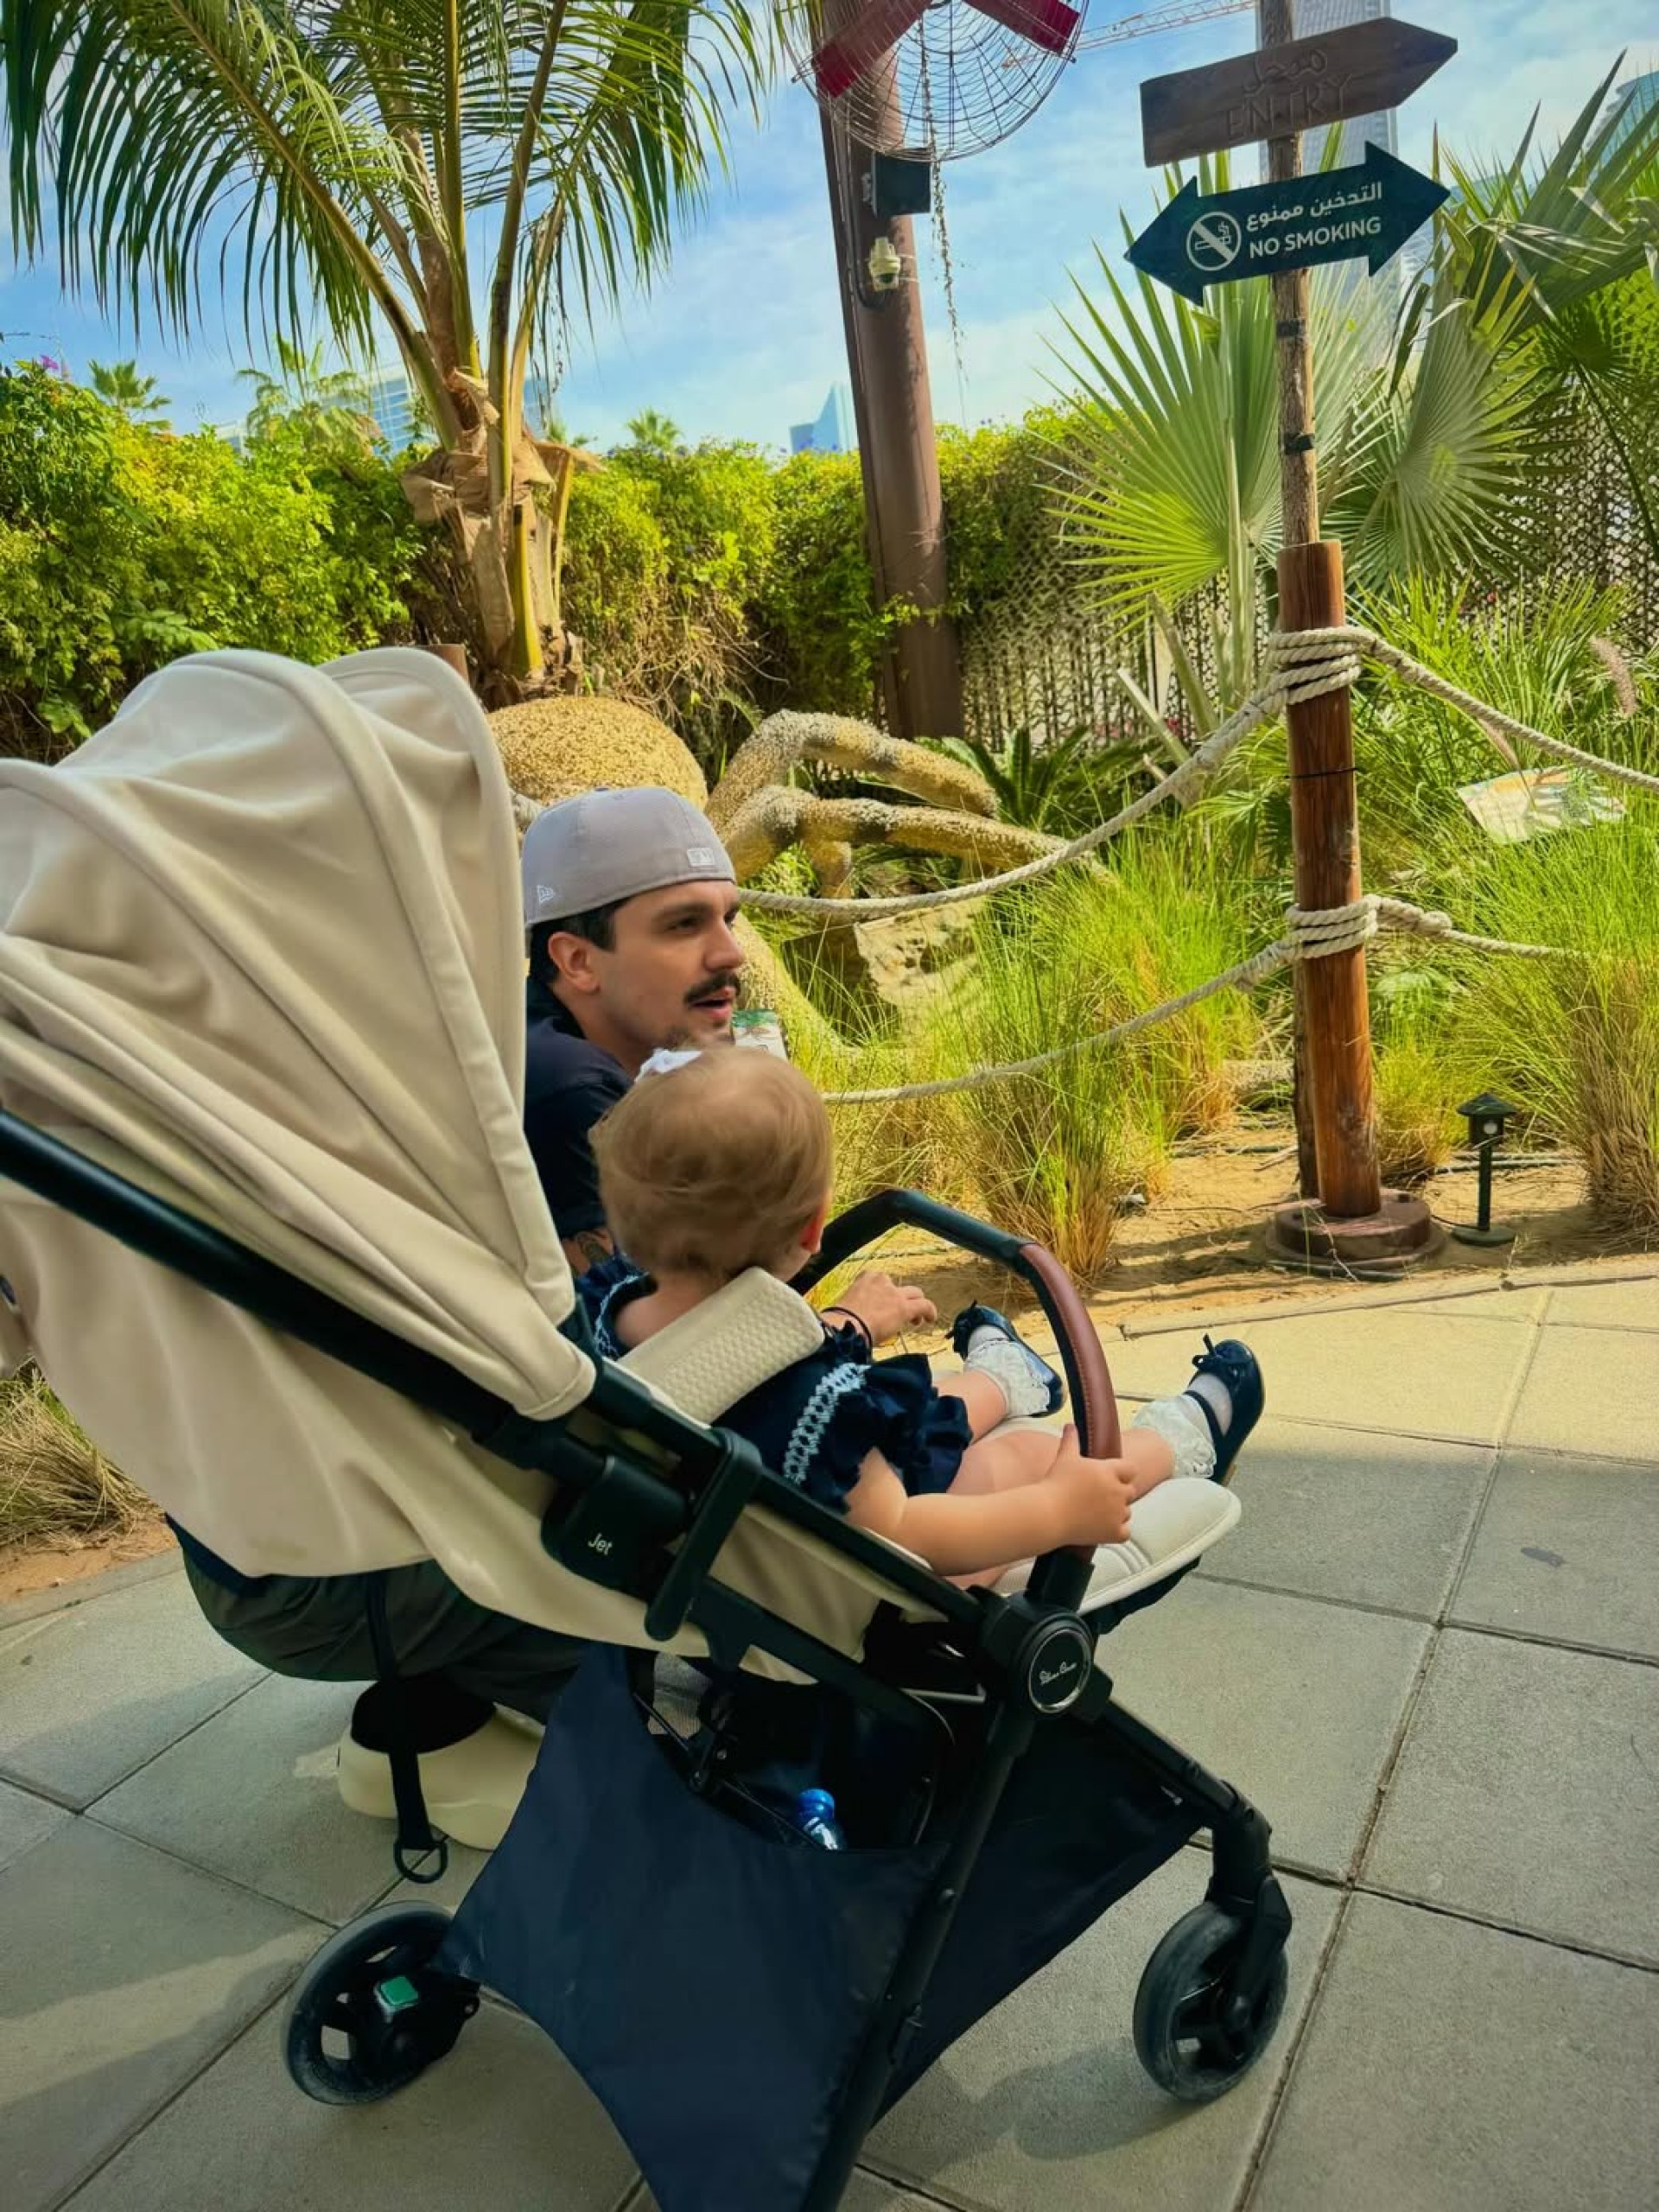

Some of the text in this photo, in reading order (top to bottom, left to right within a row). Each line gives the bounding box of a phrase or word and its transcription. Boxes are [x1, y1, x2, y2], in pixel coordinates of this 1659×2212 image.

[1227, 71, 1355, 142] ENTRY
[1246, 181, 1382, 232] التدخين ممنوع
[1249, 216, 1382, 259] NO SMOKING
[588, 1532, 613, 1555] Jet
